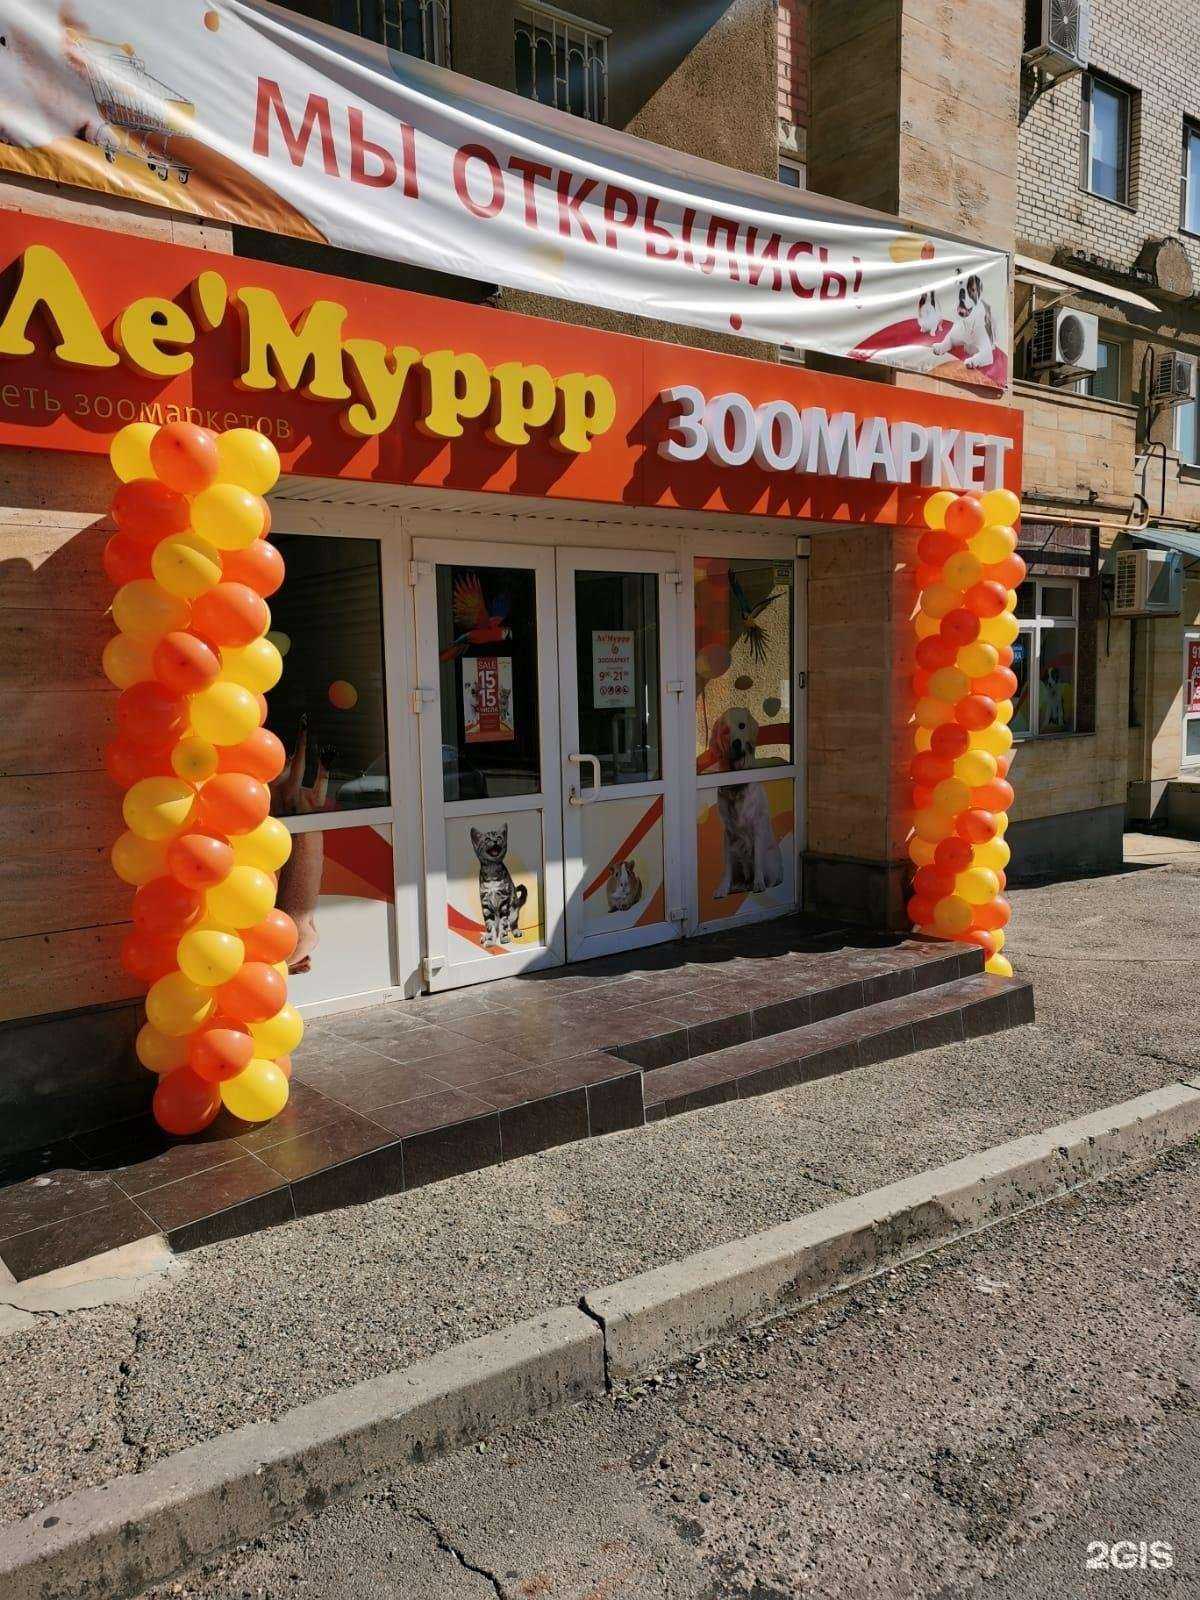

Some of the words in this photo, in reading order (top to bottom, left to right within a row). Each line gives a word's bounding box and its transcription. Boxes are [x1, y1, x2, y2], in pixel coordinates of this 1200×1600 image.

[253, 77, 420, 200] МЫ
[453, 144, 864, 309] ОТКРЫЛИСЬ!
[1, 384, 61, 411] еть
[74, 394, 291, 439] зоомаркетов
[657, 384, 1014, 492] ЗООМАРКЕТ
[478, 661, 497, 669] SALE
[478, 670, 496, 688] 15
[479, 688, 496, 707] 15
